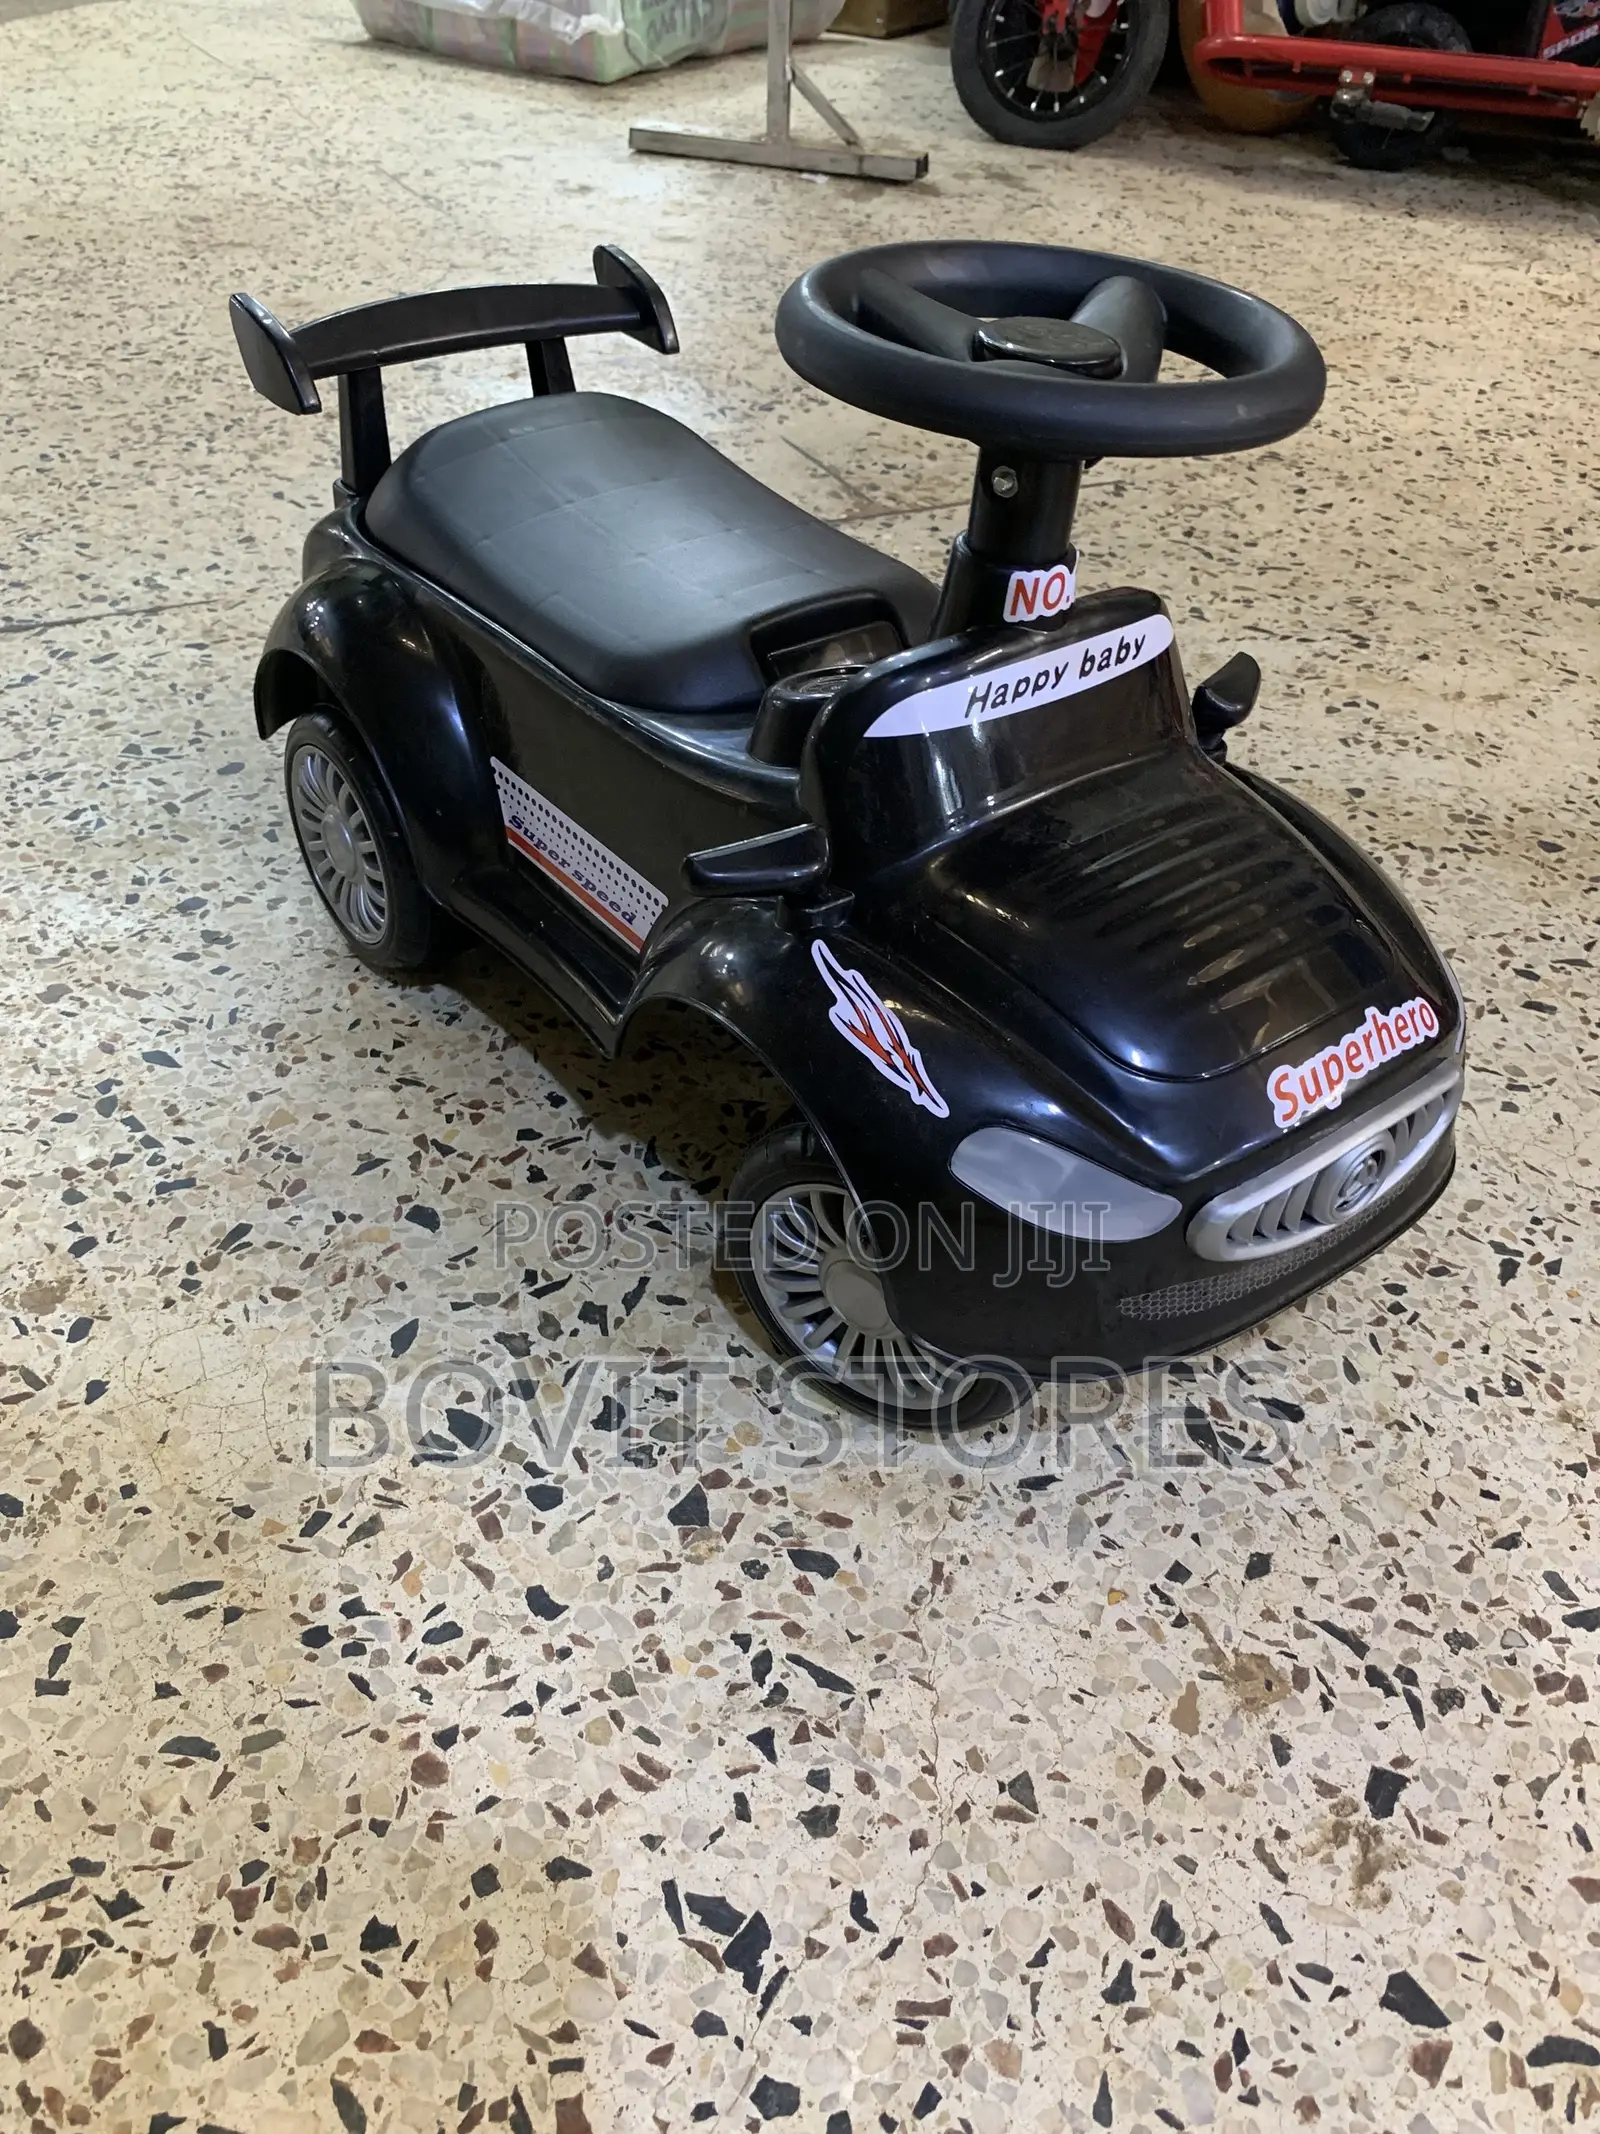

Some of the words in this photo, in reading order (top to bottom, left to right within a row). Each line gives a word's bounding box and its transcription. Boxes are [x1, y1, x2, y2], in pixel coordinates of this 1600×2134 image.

[1009, 572, 1071, 617] NO.
[964, 662, 1069, 719] Happy
[1078, 634, 1146, 680] baby
[508, 814, 571, 869] Super
[571, 869, 637, 926] speed
[1273, 1002, 1435, 1121] Superhero
